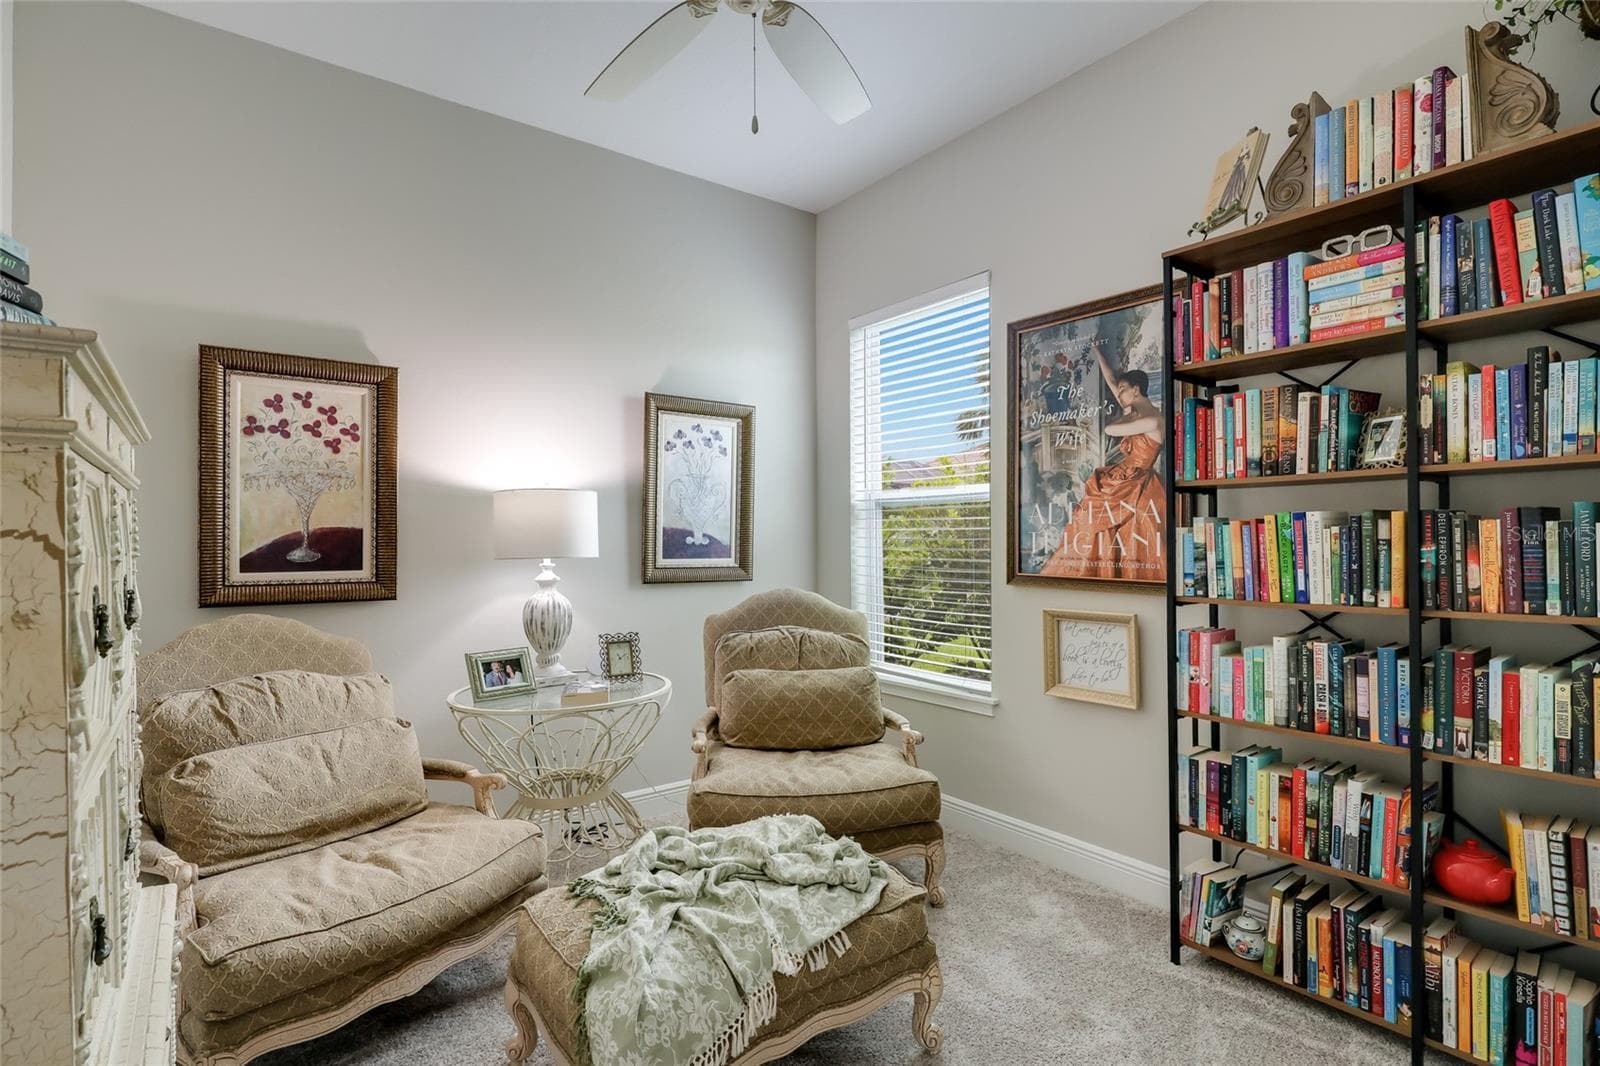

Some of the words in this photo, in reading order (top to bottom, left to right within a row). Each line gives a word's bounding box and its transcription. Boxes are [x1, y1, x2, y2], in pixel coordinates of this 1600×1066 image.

[1543, 210, 1551, 224] Dark
[1544, 225, 1553, 240] Lake
[1546, 245, 1554, 262] Sarah
[1056, 383, 1084, 401] The
[1264, 390, 1275, 401] DAN
[1284, 387, 1292, 402] DAN
[1030, 400, 1115, 426] Shoemaker's
[1264, 403, 1275, 422] BROWN
[1054, 430, 1087, 448] Wife
[1028, 498, 1162, 526] ADRIANA
[1438, 513, 1446, 533] DELIA
[1028, 531, 1162, 558] TRIGIANI
[1439, 537, 1448, 565] EPHRON
[1315, 645, 1323, 655] LISA
[1315, 658, 1323, 680] GARDNER
[1399, 665, 1407, 690] BRIDAL
[1316, 684, 1326, 702] CRASH
[1461, 668, 1472, 704] VICTORIA
[1476, 676, 1485, 709] CHANEL
[1399, 694, 1407, 717] CHAIR
[1373, 950, 1381, 994] MUDBOUND
[1424, 960, 1441, 992] Alibi
[1515, 975, 1525, 1003] Kinsella
[1523, 980, 1536, 1005] Sophie
